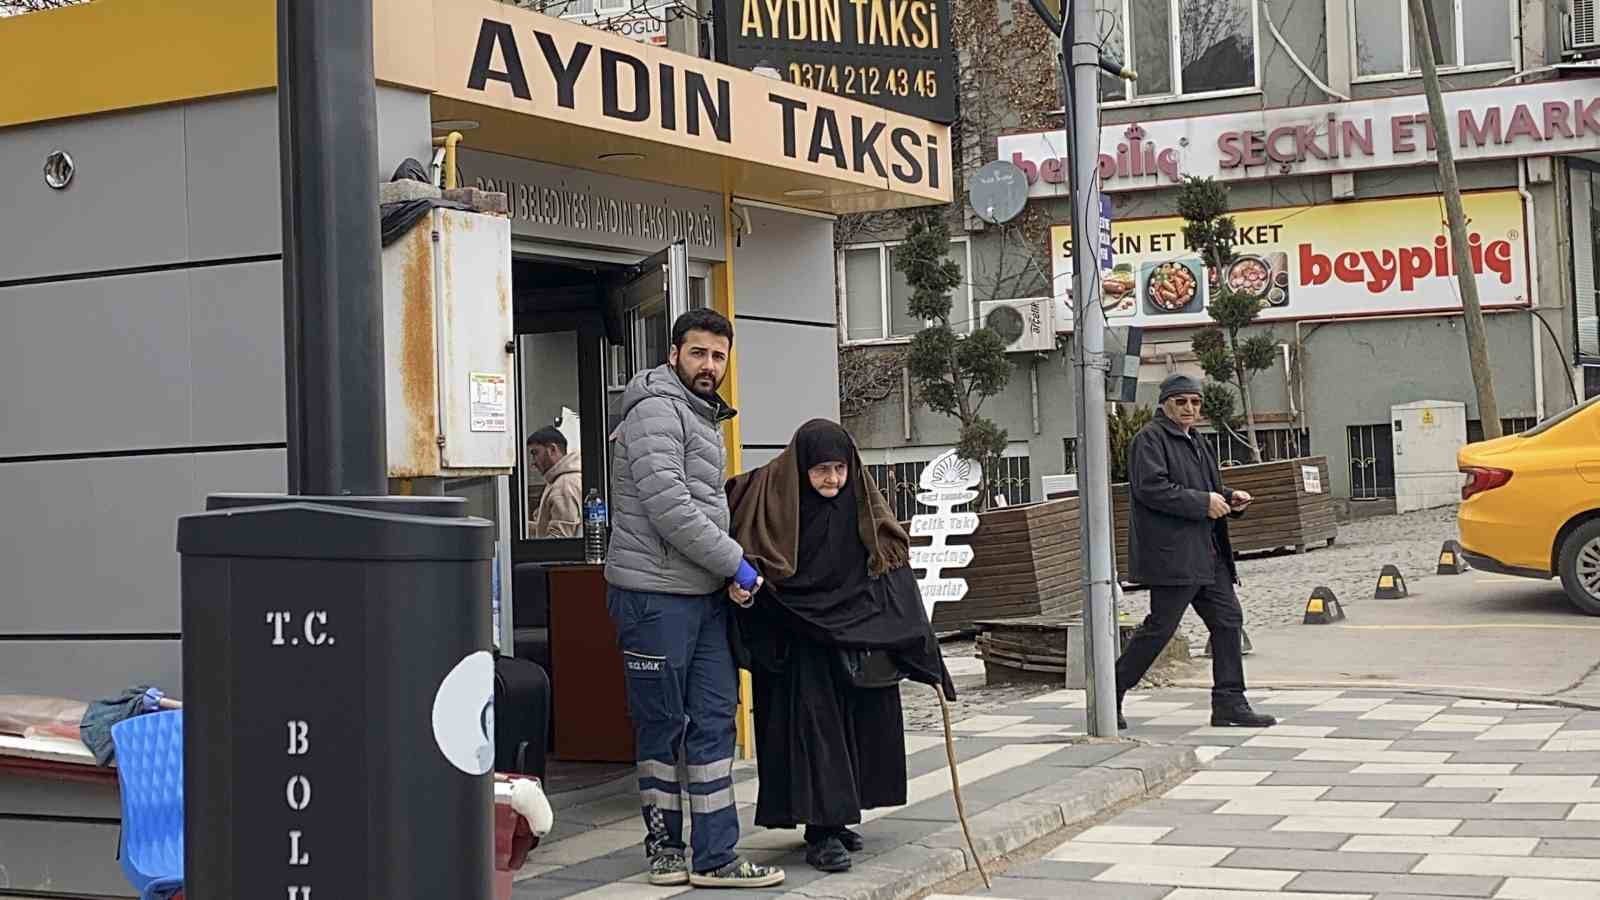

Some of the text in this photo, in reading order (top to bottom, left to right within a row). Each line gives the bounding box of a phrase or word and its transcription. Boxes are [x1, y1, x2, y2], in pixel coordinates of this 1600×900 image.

[741, 0, 841, 43] AYDIN
[467, 18, 731, 144] AYDIN
[789, 63, 937, 98] 0374 212 43 45
[1217, 97, 1600, 173] SEÇKİN ET MARK
[519, 181, 593, 231] BELEDİYESİ
[596, 195, 634, 237] AYDIN
[634, 198, 669, 242] TAKSİ
[671, 203, 716, 249] DURAĞI
[1151, 233, 1176, 252] ET
[266, 611, 335, 646] T.C.
